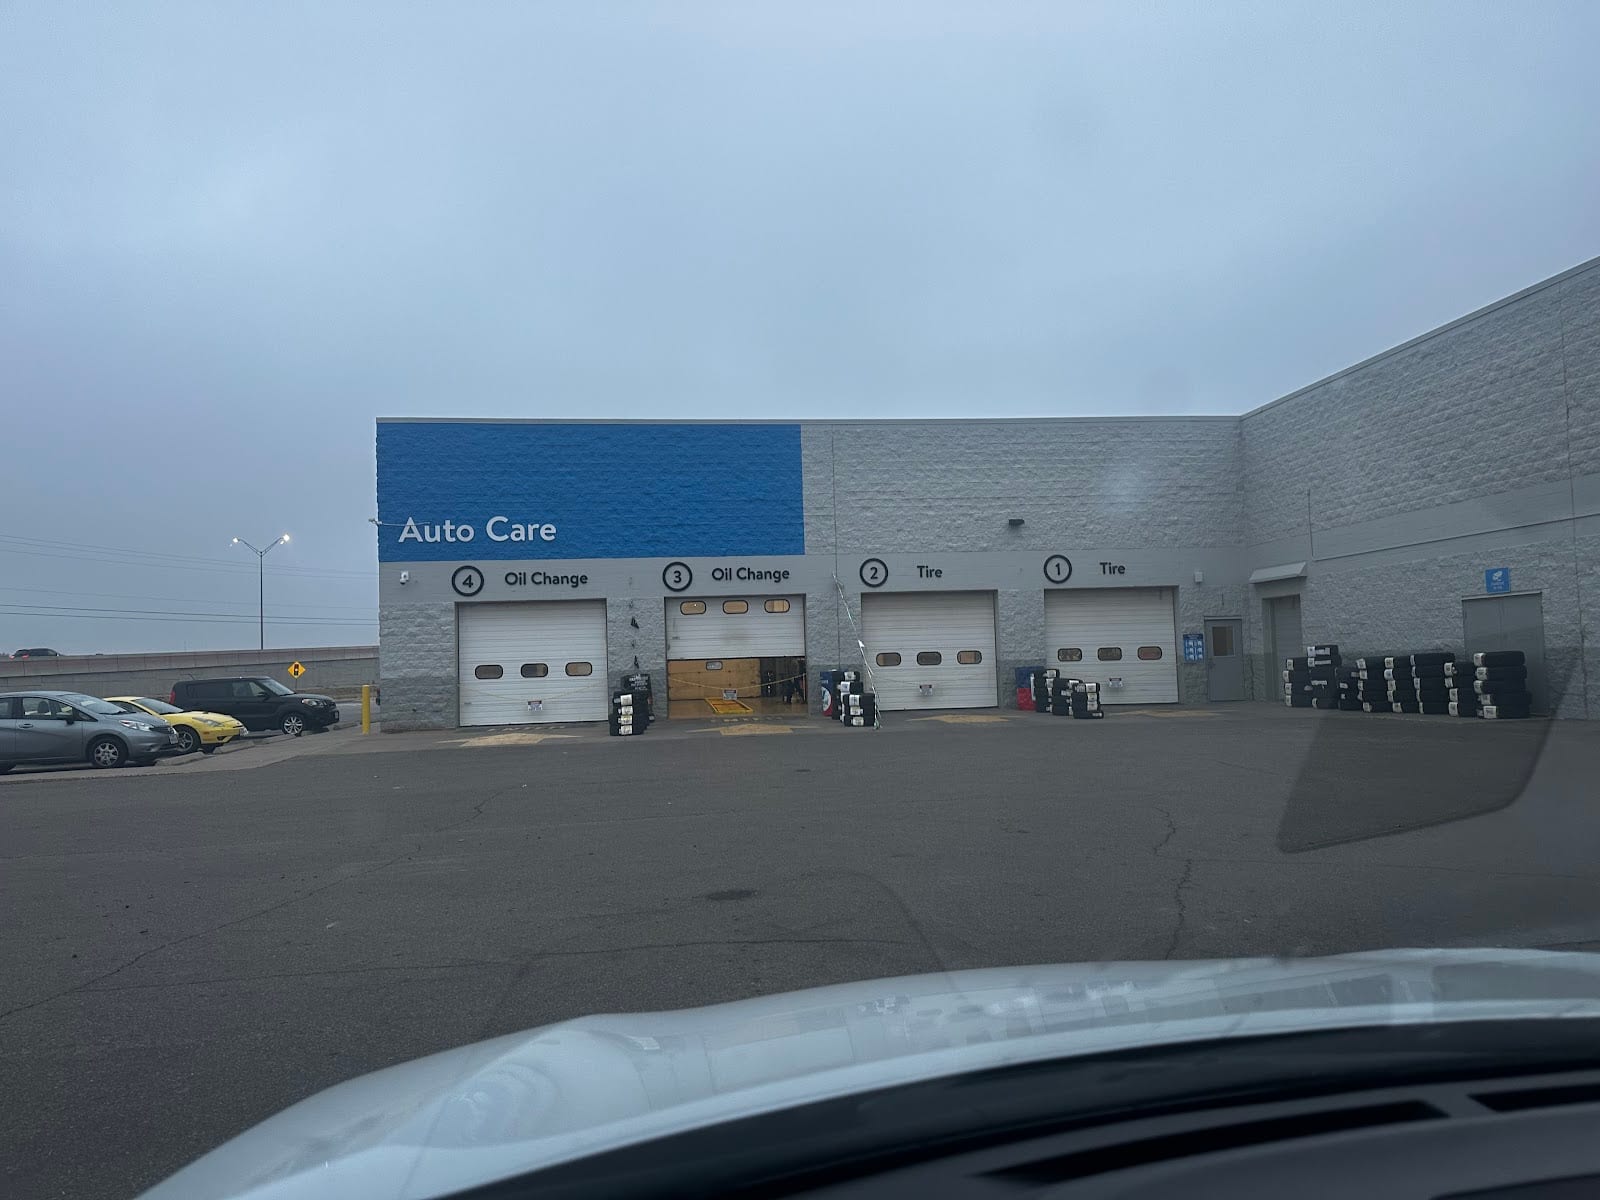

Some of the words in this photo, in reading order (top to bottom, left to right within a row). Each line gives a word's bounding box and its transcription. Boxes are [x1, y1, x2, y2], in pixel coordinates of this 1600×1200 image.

[398, 516, 475, 543] Auto
[486, 515, 557, 542] Care
[673, 570, 682, 583] 3
[711, 567, 732, 581] Oil
[736, 567, 790, 583] Change
[870, 566, 878, 580] 2
[916, 565, 943, 578] Tire
[1055, 562, 1061, 576] 1
[1099, 561, 1126, 575] Tire
[462, 574, 474, 588] 4
[504, 571, 527, 586] Oil
[531, 571, 589, 588] Change
